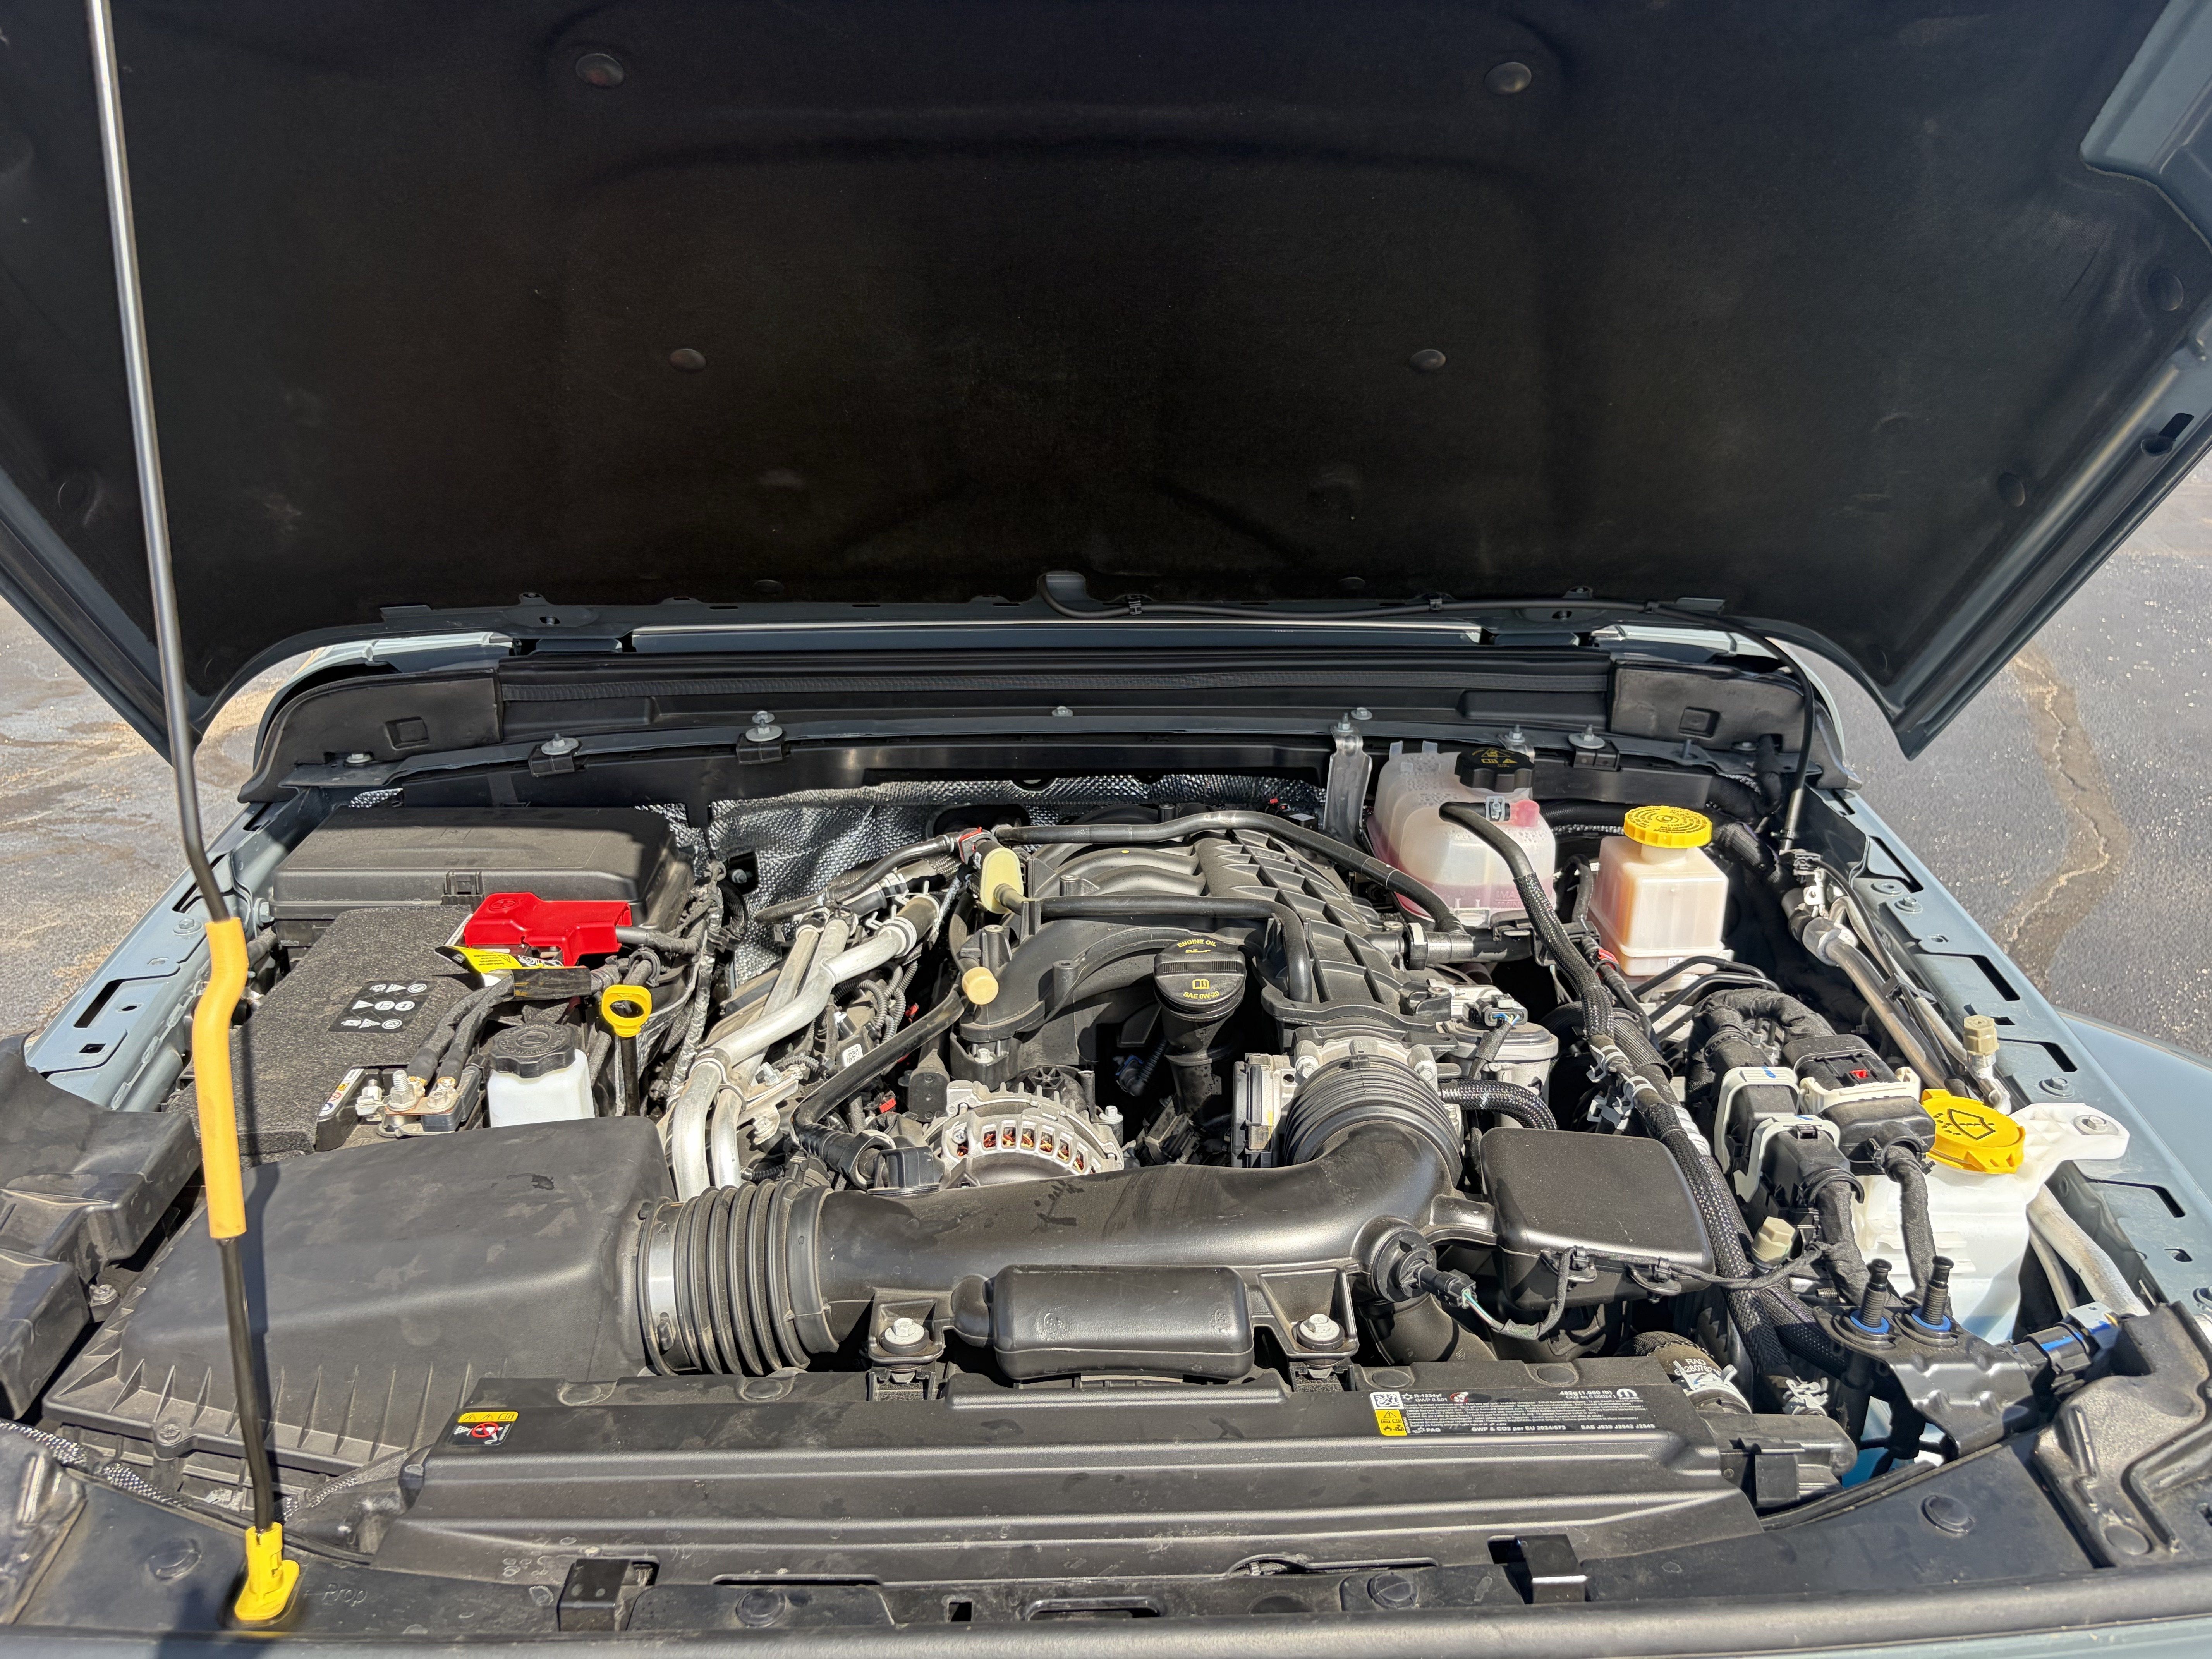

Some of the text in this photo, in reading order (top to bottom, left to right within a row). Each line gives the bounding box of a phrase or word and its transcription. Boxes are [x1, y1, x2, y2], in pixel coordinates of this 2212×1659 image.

[1177, 939, 1204, 948] ENGINE
[1199, 991, 1220, 999] 0W-20
[322, 1583, 367, 1607] Prop
